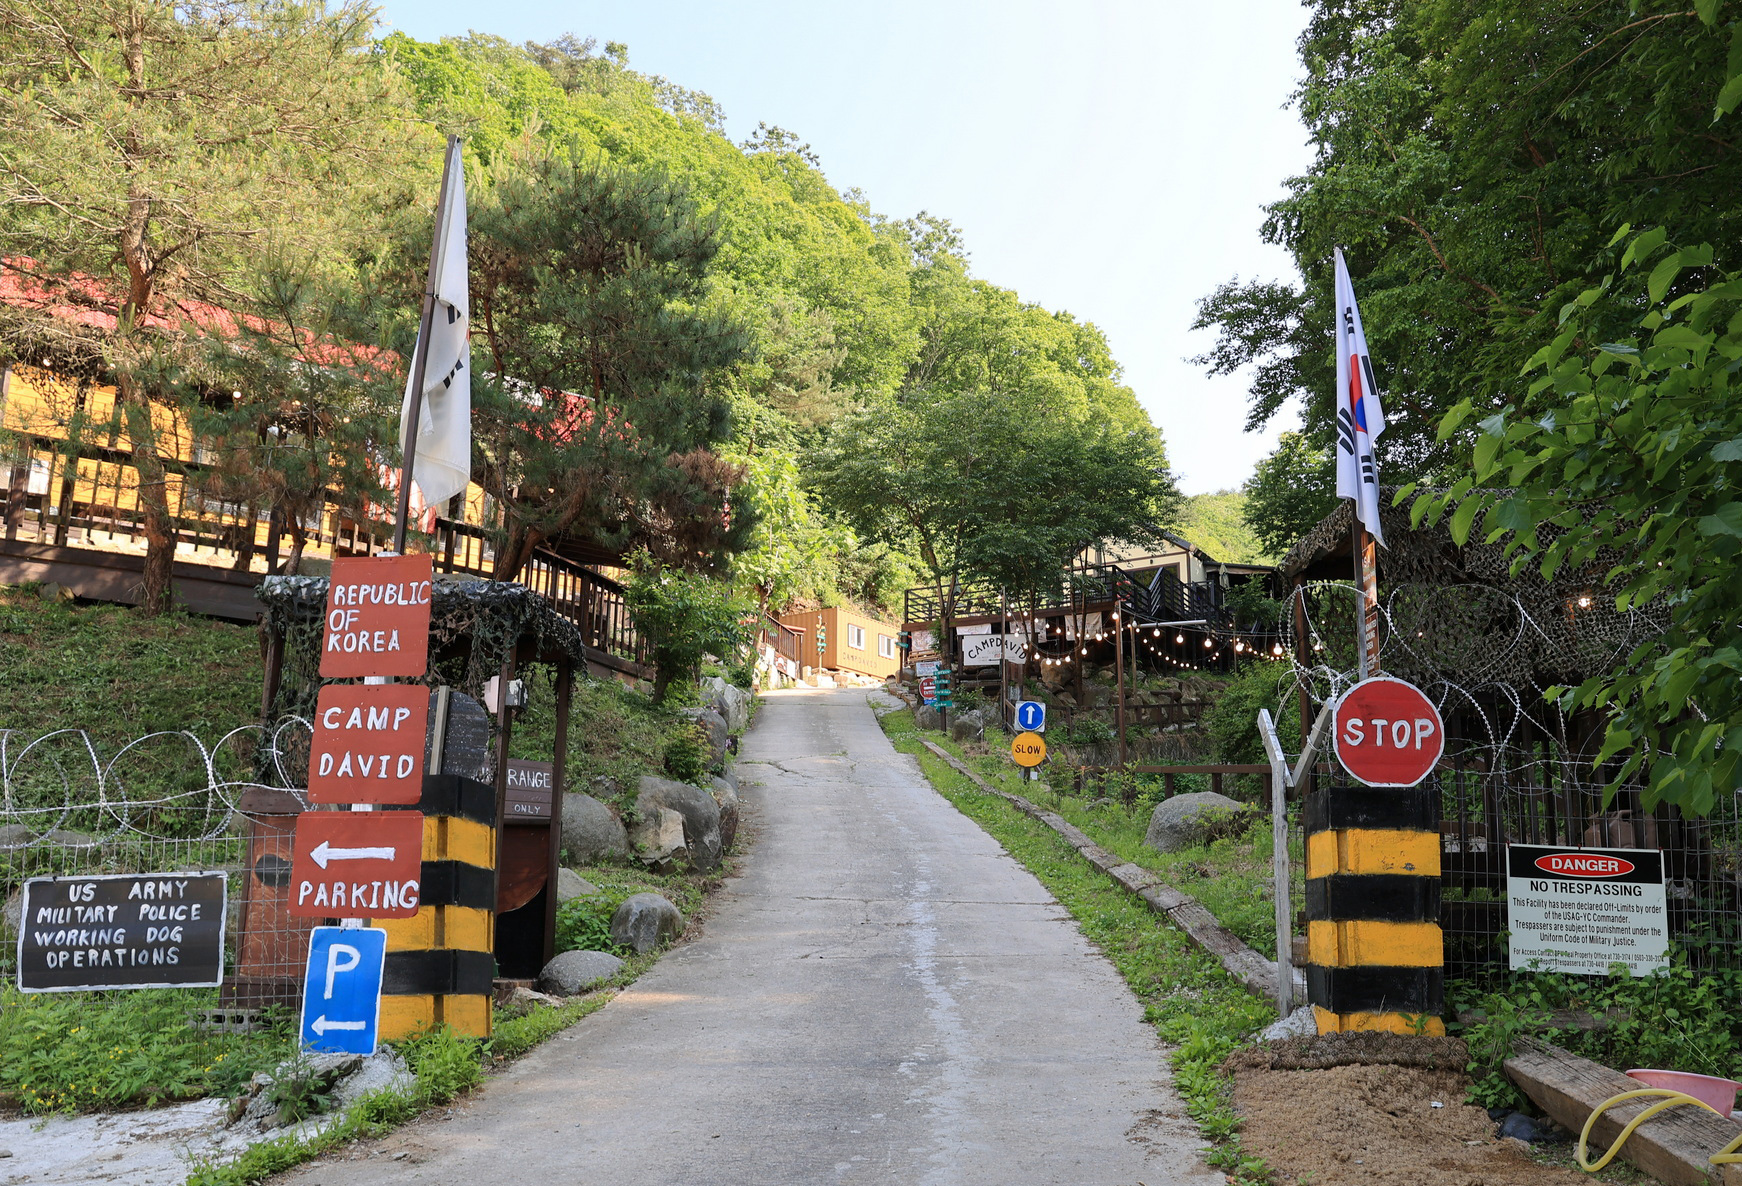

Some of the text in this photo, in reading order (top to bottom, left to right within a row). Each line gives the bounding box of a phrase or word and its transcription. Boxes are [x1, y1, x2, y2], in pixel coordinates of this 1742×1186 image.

[334, 580, 430, 606] REPUBLIC
[329, 608, 360, 632] OF
[327, 629, 400, 654] KOREA
[322, 706, 410, 731] CAMP
[1343, 717, 1435, 750] STOP
[1014, 744, 1041, 755] SLOW
[318, 751, 414, 779] DAVID
[507, 768, 551, 788] RANGE
[514, 804, 541, 814] ONLY
[1551, 857, 1619, 872] DANGER
[69, 880, 188, 902] US ARMY
[298, 879, 419, 909] PARKING
[1530, 880, 1642, 896] NO TRESPASSING
[36, 903, 201, 924] MILITARY POLICE
[1513, 897, 1662, 914] This Facility has been declared Off-Limits by order
[1544, 911, 1631, 923] of the USAG-YC Commander.
[34, 925, 184, 947] WORKING DOG
[1515, 920, 1662, 936] Trespassers are subject to punishment under the
[1540, 933, 1637, 947] Uniform Code of Military Justice.
[46, 946, 180, 969] OPERATIONS
[1521, 948, 1537, 956] Access
[1574, 951, 1593, 960] Property
[1594, 952, 1607, 960] Office
[323, 943, 361, 1000] P
